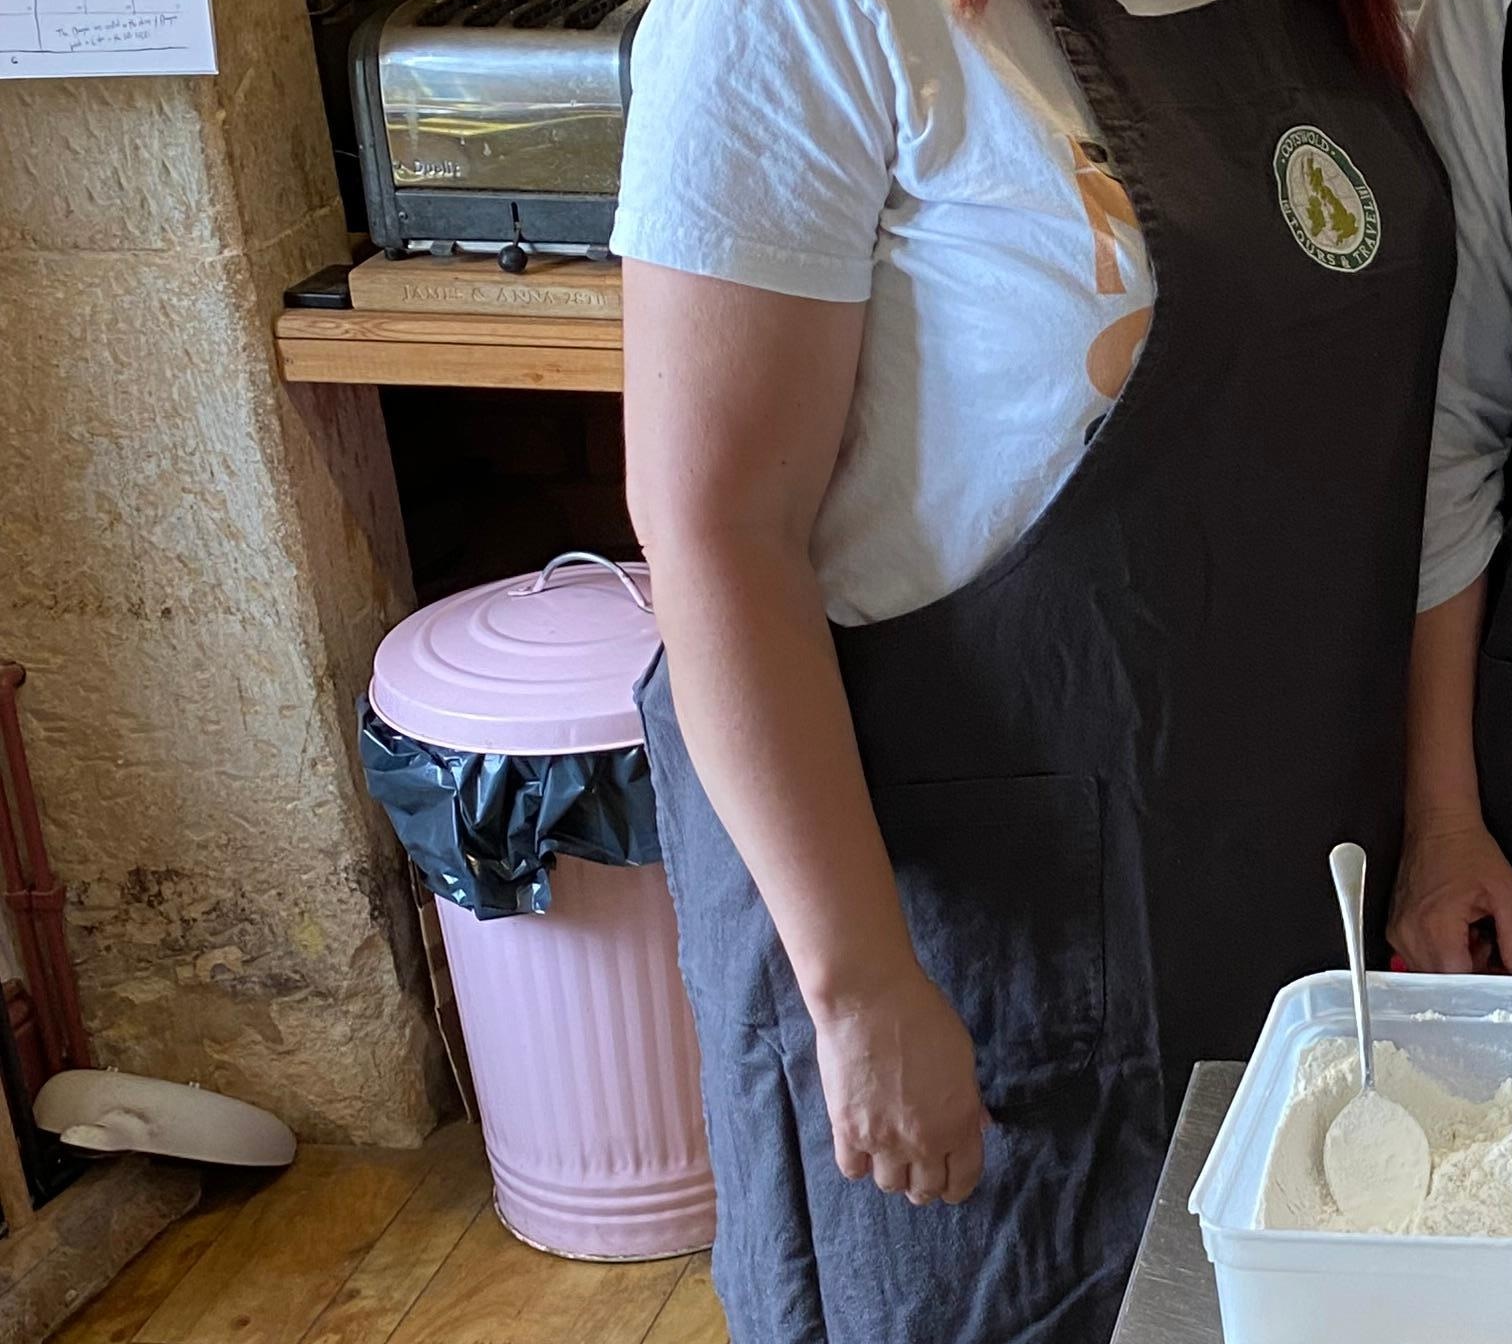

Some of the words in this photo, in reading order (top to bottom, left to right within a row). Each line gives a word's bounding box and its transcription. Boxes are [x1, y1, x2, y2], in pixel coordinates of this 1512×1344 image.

[1290, 220, 1335, 265] TOURS
[1340, 256, 1351, 268] &
[1352, 201, 1377, 264] TRAVEL
